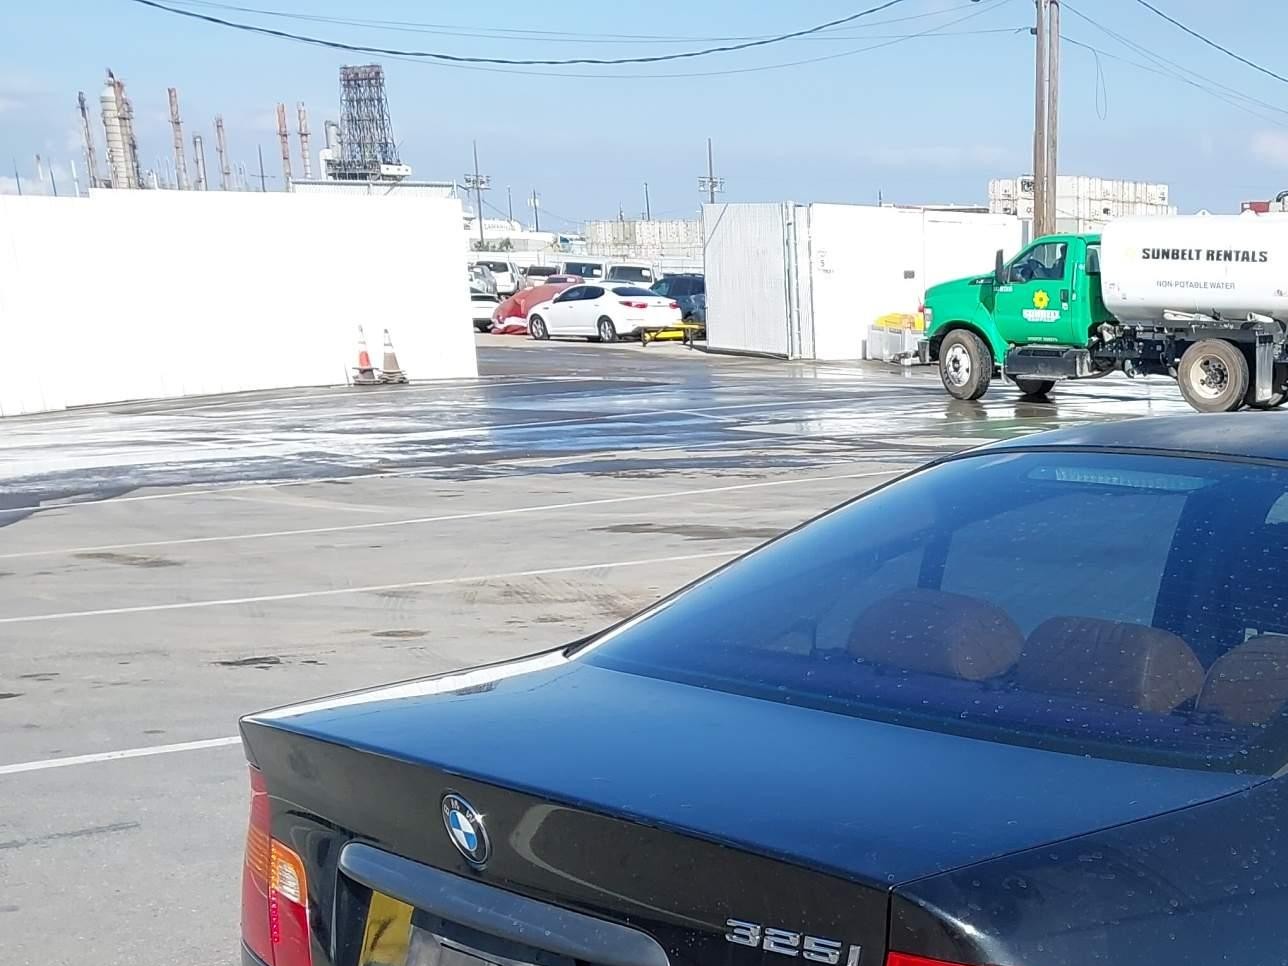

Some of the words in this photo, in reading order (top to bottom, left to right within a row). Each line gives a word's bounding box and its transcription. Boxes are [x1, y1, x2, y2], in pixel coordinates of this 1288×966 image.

[1142, 248, 1203, 261] SUNBELT
[1206, 249, 1268, 263] RENTALS
[443, 798, 476, 824] BMW
